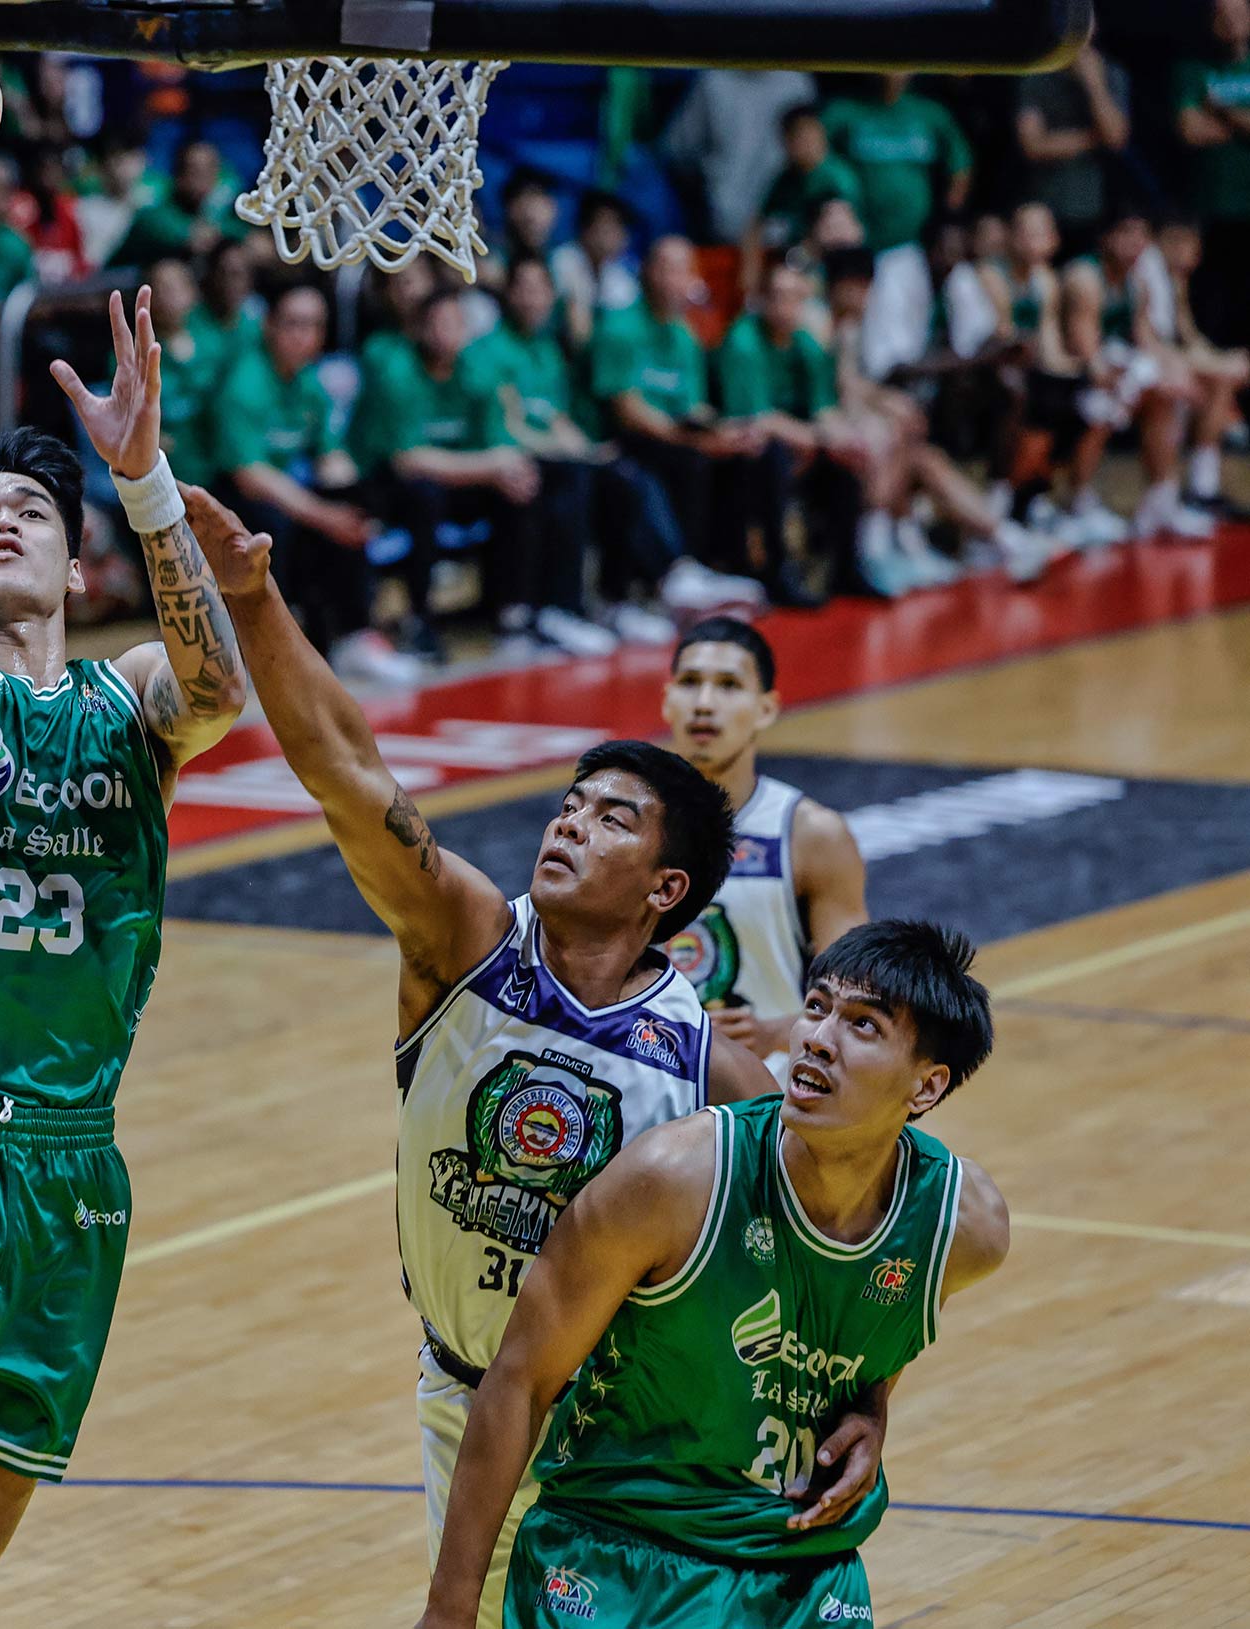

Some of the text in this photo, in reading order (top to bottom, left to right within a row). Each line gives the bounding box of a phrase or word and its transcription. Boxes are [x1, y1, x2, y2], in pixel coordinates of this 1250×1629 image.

[15, 768, 132, 814] EcoOil
[23, 824, 105, 857] Salle
[543, 1050, 591, 1075] SJDMCCI
[505, 1089, 569, 1124] CORNERSTONE
[562, 1105, 581, 1154] COLLEGE
[431, 1155, 558, 1242] YENGSKI
[478, 1246, 524, 1298] 31
[752, 1370, 782, 1404] La
[741, 1415, 817, 1496] 20
